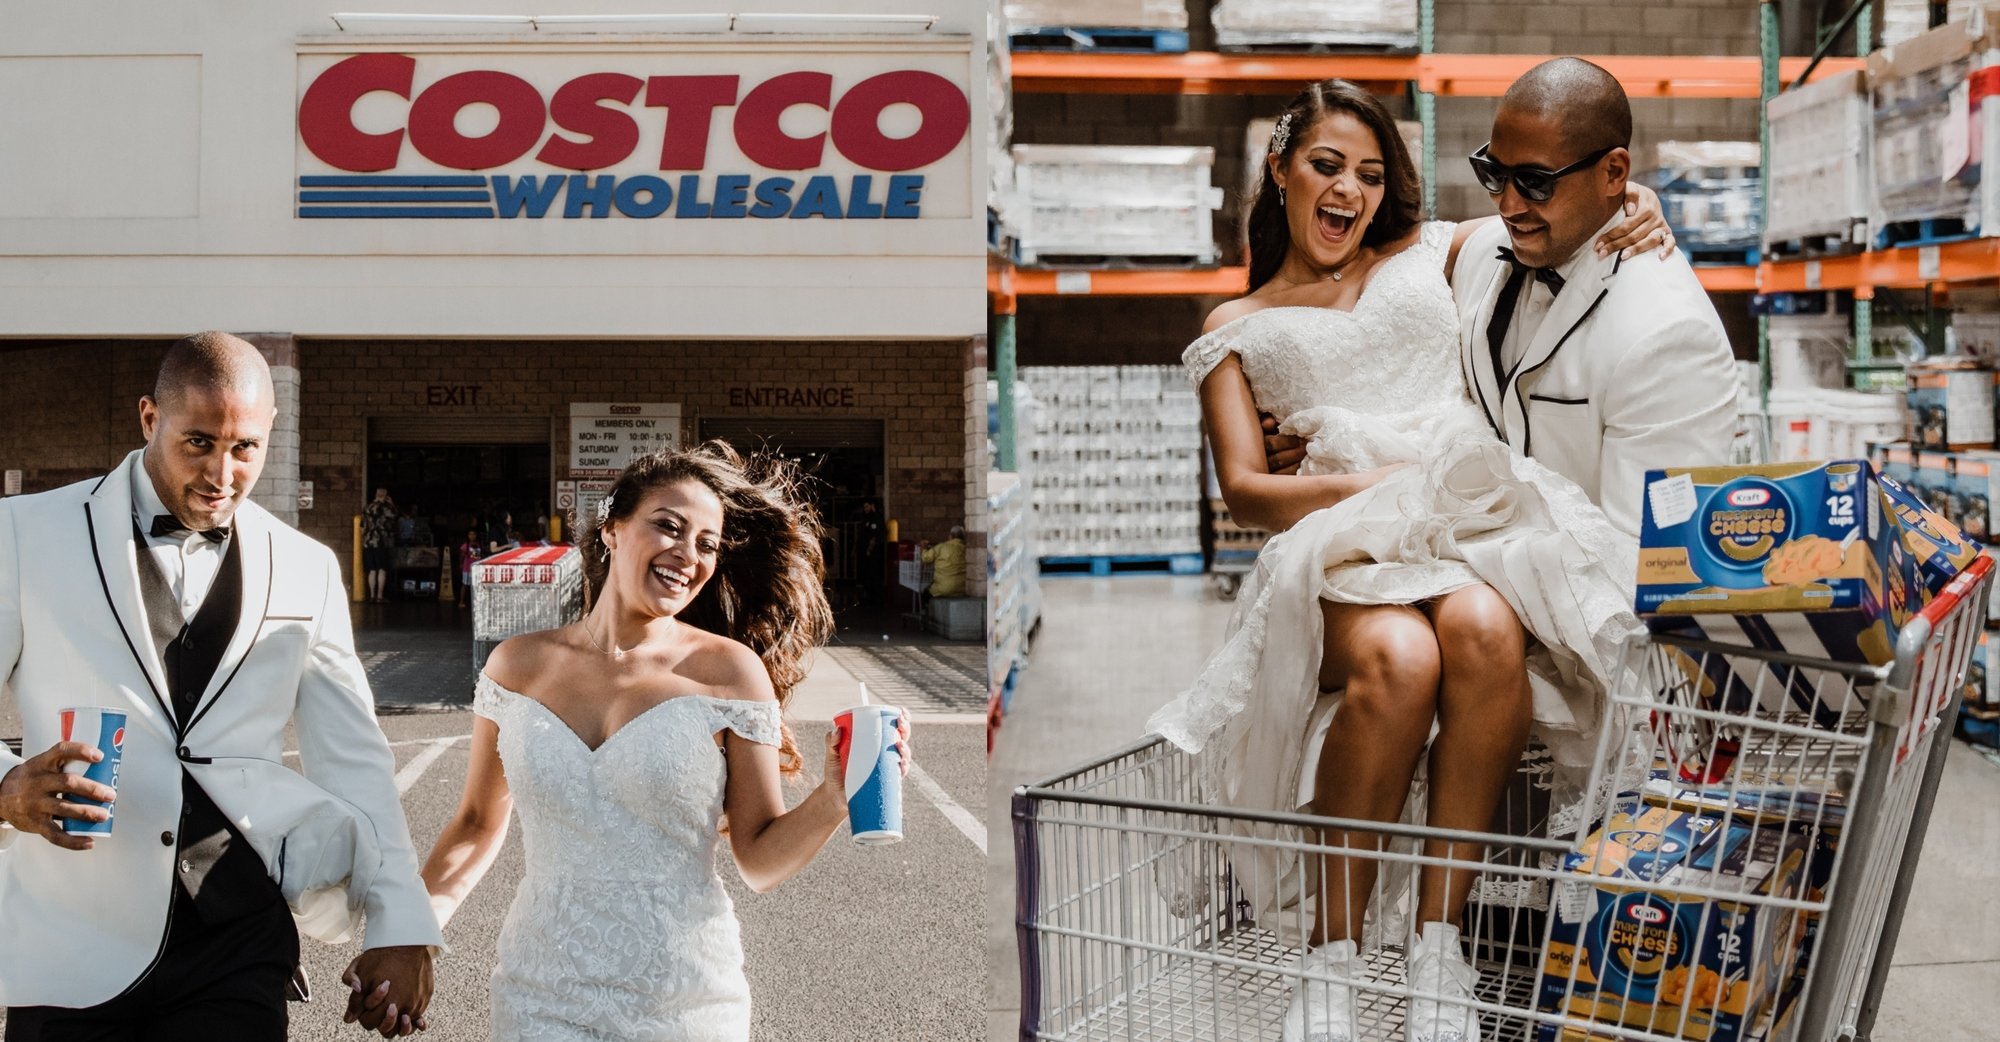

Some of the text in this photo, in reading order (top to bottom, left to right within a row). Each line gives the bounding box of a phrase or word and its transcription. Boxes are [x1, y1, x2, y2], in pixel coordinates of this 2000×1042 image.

[298, 52, 970, 172] COSTCO
[491, 174, 925, 220] WHOLESALE
[426, 385, 482, 406] EXIT
[729, 387, 855, 408] ENTRANCE
[595, 420, 657, 428] MEMBERS ONLY
[578, 432, 597, 441] MON
[603, 432, 616, 441] FRI
[629, 432, 650, 441] 10:00
[578, 445, 620, 454] SATURDAY
[578, 458, 610, 467] SUNDAY
[1736, 493, 1760, 502] Kraft
[1826, 495, 1854, 517] 12
[1828, 515, 1855, 528] cups
[1645, 556, 1688, 570] original
[108, 758, 121, 818] ppsi
[1634, 907, 1658, 920] Kaft
[1614, 919, 1669, 940] macroni
[1717, 932, 1741, 954] 12
[1549, 950, 1588, 966] origial
[1717, 952, 1741, 963] cps
